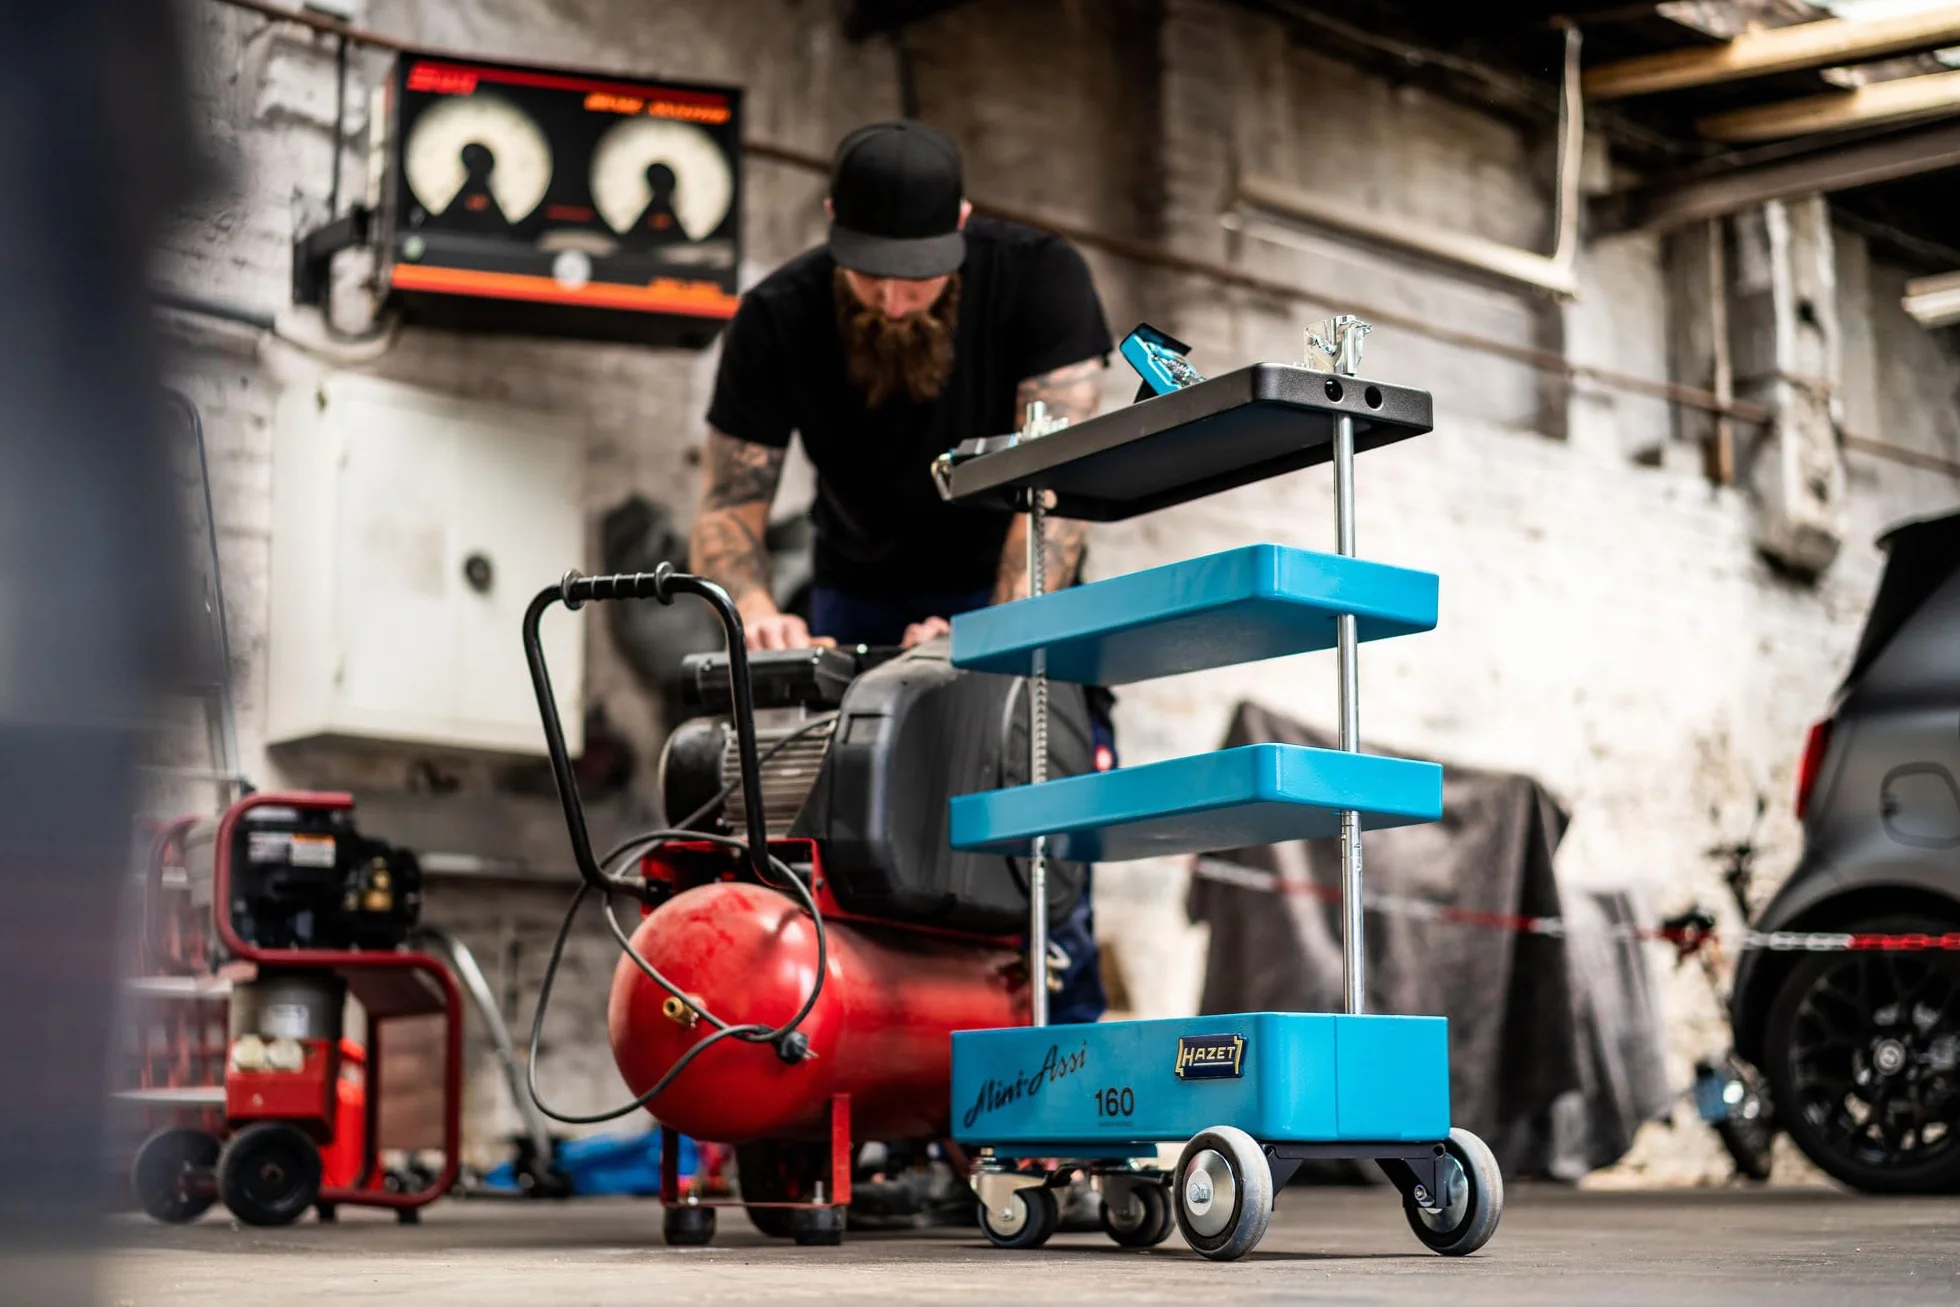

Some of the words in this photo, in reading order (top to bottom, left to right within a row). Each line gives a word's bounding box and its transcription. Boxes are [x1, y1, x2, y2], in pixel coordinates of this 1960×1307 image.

[1181, 1045, 1236, 1067] HAZET
[963, 1039, 1088, 1129] Mini-Assi
[1094, 1086, 1135, 1117] 160
